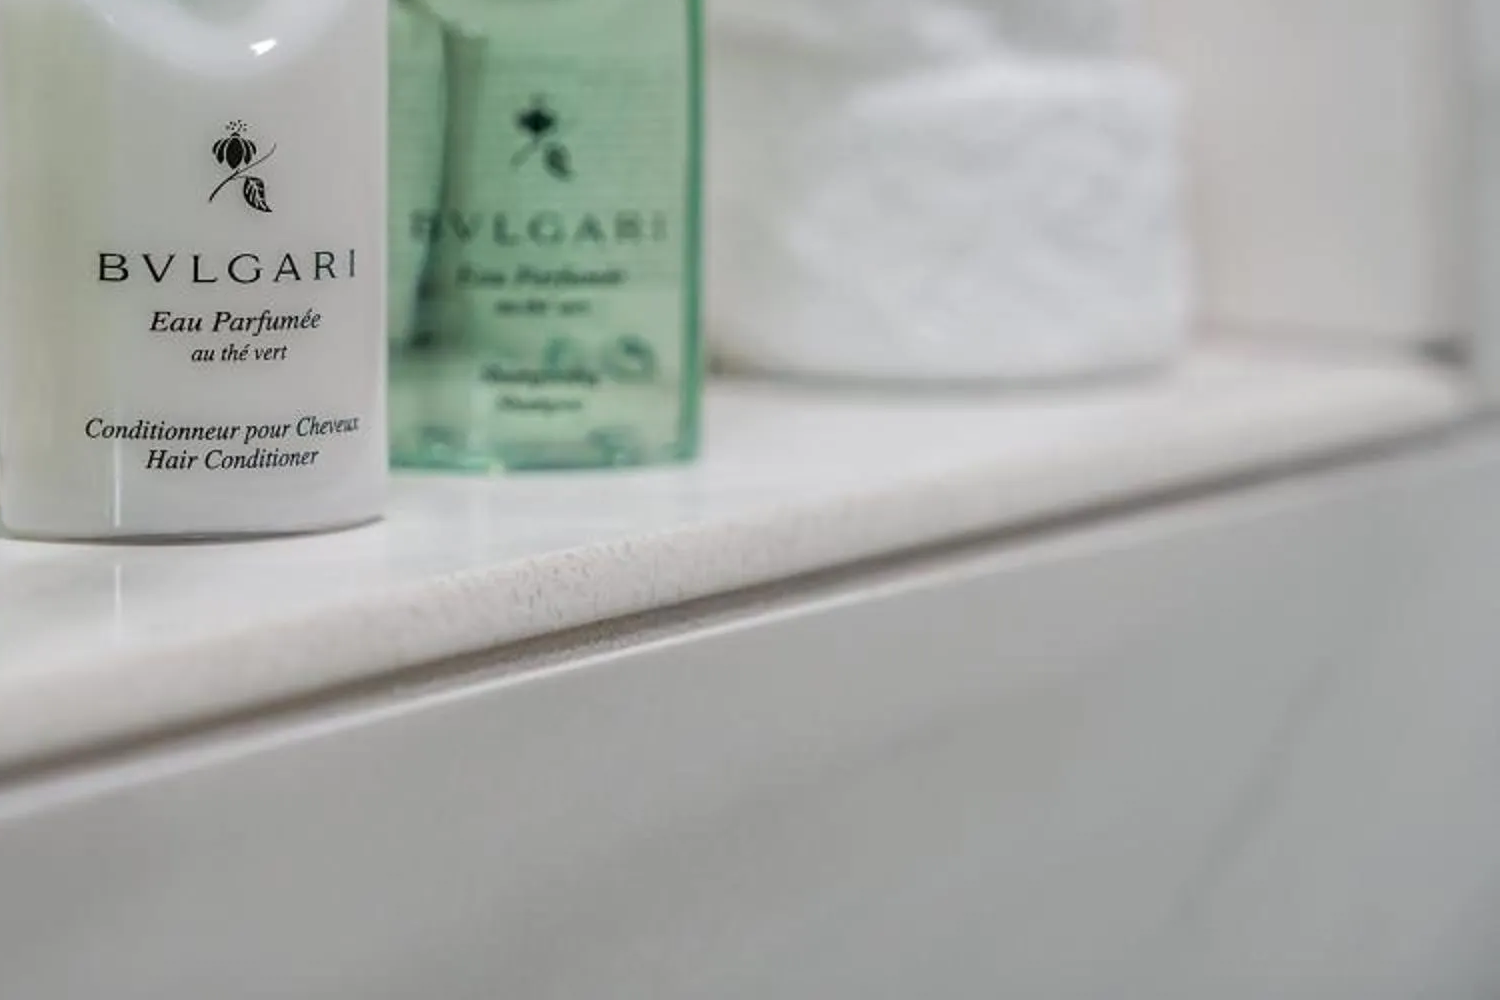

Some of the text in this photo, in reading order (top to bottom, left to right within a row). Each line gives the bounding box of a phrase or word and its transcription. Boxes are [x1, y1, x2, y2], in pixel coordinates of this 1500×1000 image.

[98, 248, 356, 285] BVLGARI
[149, 307, 321, 337] Eau Parfumée
[190, 343, 288, 363] au thé vert
[84, 415, 359, 445] Conditionneur pour Cheveux
[144, 448, 320, 471] Hair Conditioner
